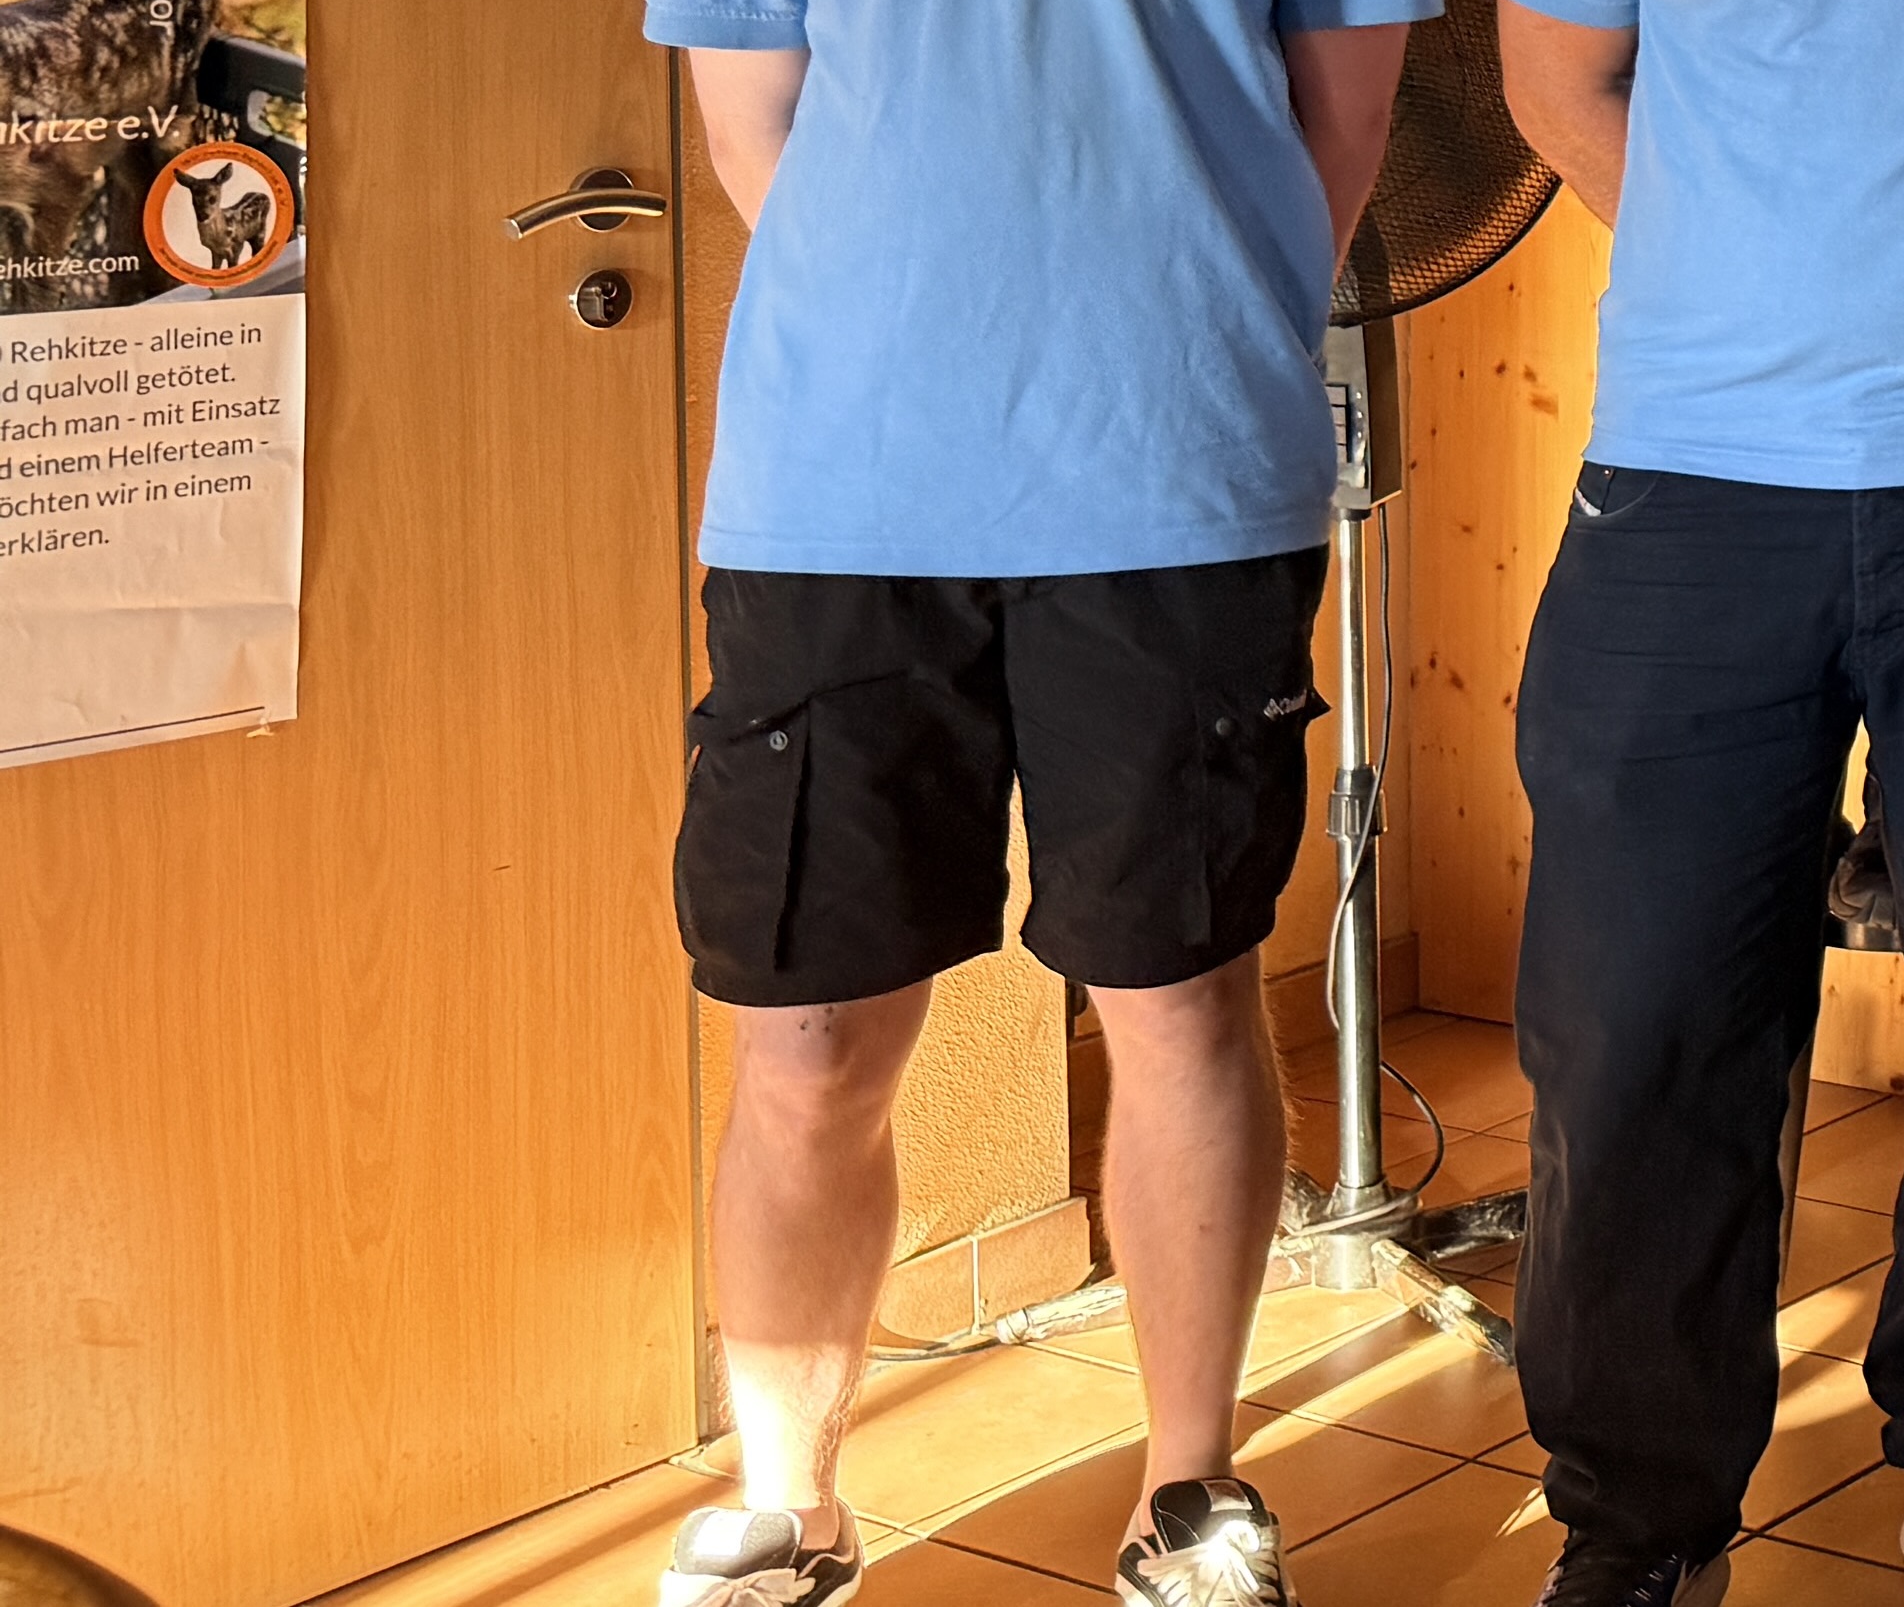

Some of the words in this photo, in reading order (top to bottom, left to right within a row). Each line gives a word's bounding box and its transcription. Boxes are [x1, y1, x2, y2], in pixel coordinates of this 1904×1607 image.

[117, 105, 181, 140] e.V.
[11, 334, 129, 364] Rehkitze
[150, 326, 234, 353] alleine
[240, 323, 262, 345] in
[26, 370, 129, 405] qualvoll
[136, 362, 236, 396] getötet.
[65, 413, 120, 437] man
[143, 404, 184, 428] mit
[191, 394, 281, 423] Einsatz
[19, 448, 100, 479] einem
[108, 436, 254, 468] Helferteam
[97, 481, 139, 506] wir
[145, 477, 168, 501] in
[174, 473, 252, 498] einem
